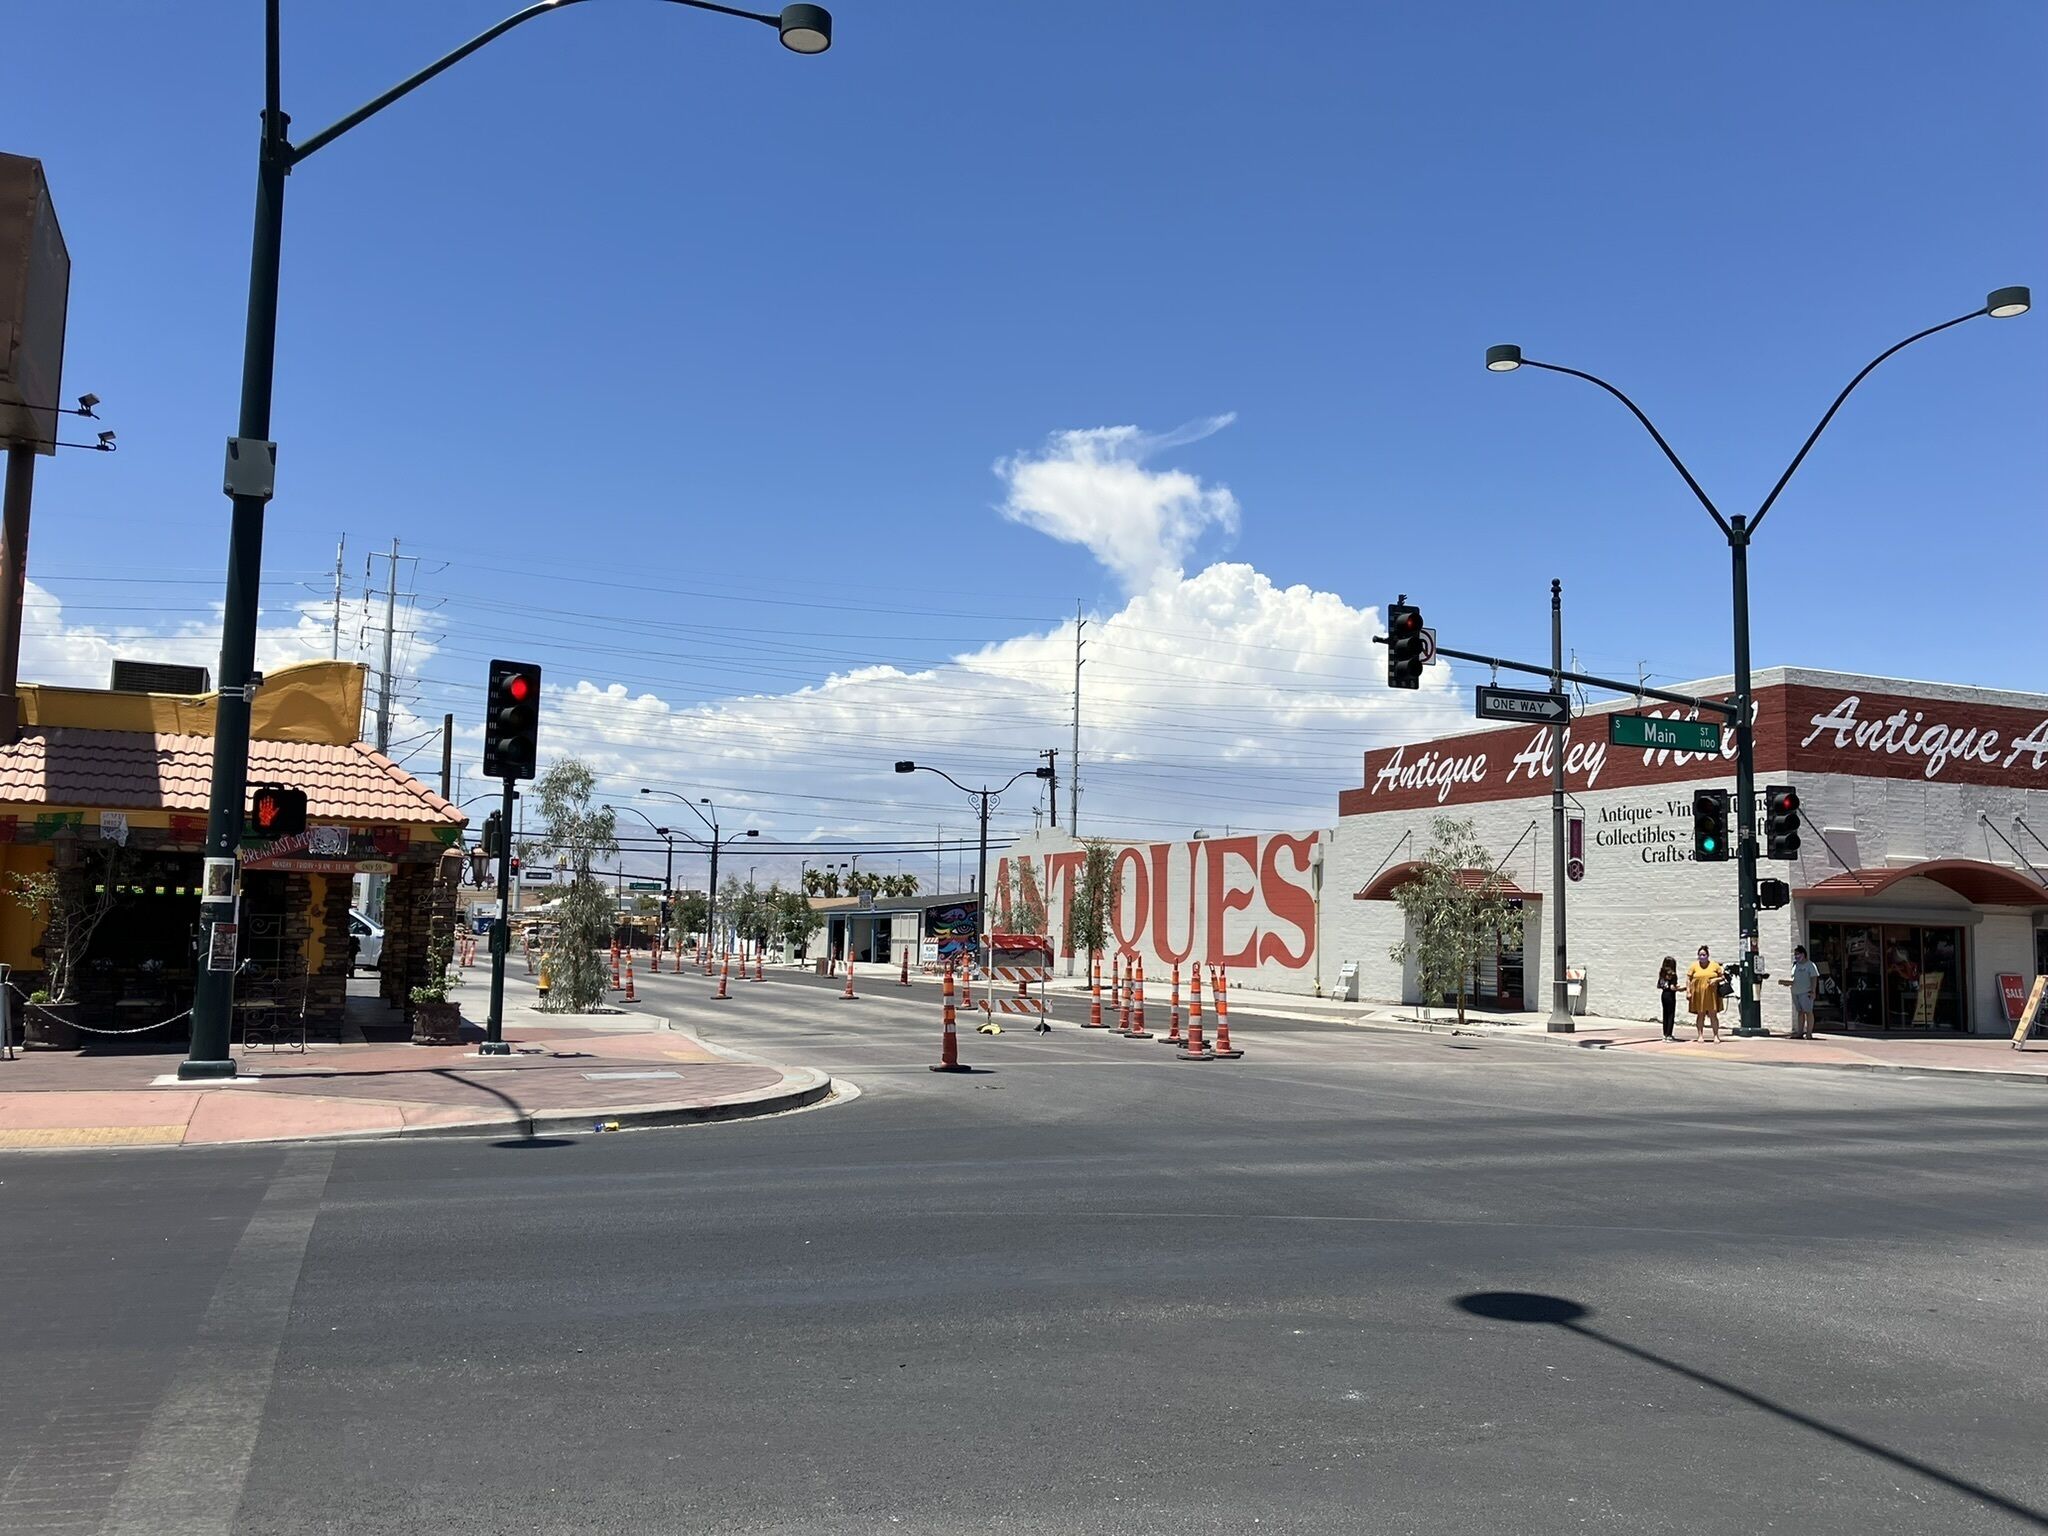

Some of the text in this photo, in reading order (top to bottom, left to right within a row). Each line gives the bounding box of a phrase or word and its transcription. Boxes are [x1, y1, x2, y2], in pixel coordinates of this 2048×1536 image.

[1492, 698, 1544, 713] ONE WAY
[1615, 719, 1709, 744] S Main ST
[1800, 695, 2001, 779] Antique
[1700, 738, 1716, 749] 1100
[1371, 745, 1487, 804] Antique
[1598, 805, 1653, 825] Antique
[1596, 826, 1676, 847] Collectibles
[1641, 846, 1685, 864] Crafts
[2005, 987, 2024, 999] SALE
